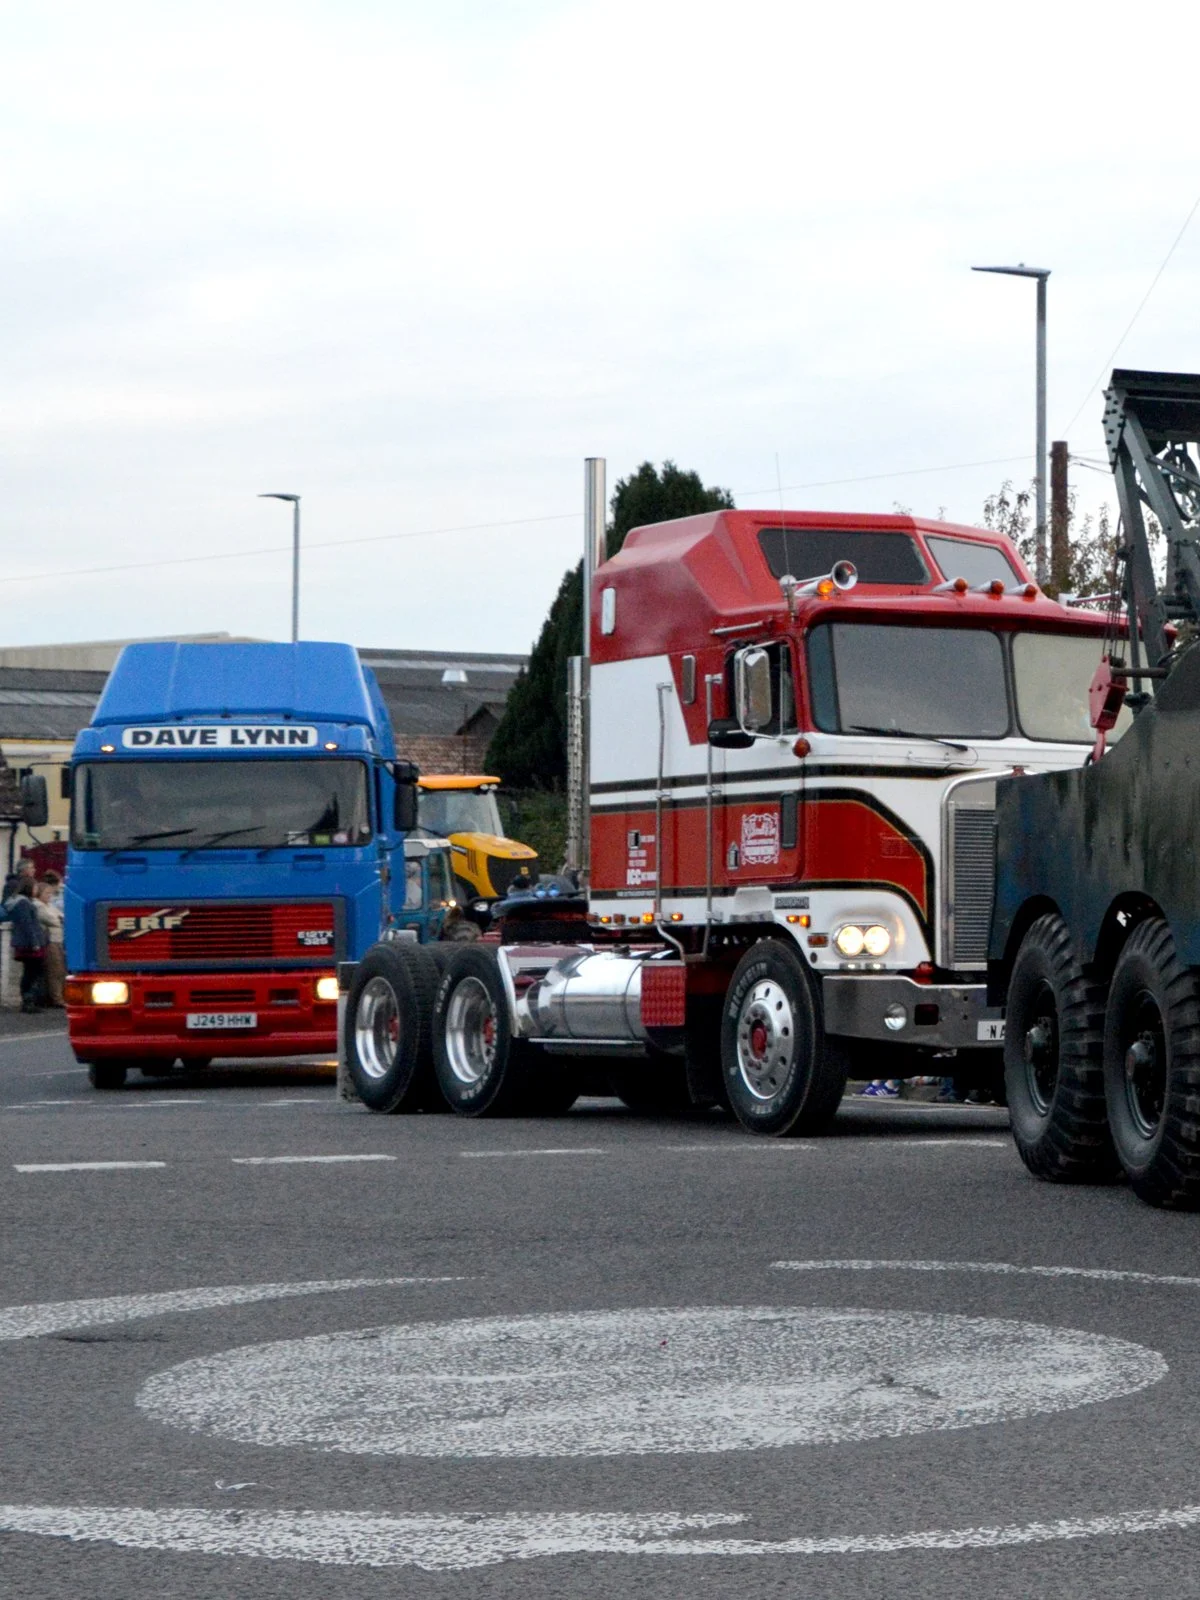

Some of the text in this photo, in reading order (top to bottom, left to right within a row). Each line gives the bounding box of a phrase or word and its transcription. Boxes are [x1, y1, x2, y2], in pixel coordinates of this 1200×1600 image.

[131, 729, 310, 746] DAVE LYNN
[115, 914, 184, 931] ERF
[193, 1014, 225, 1027] J249
